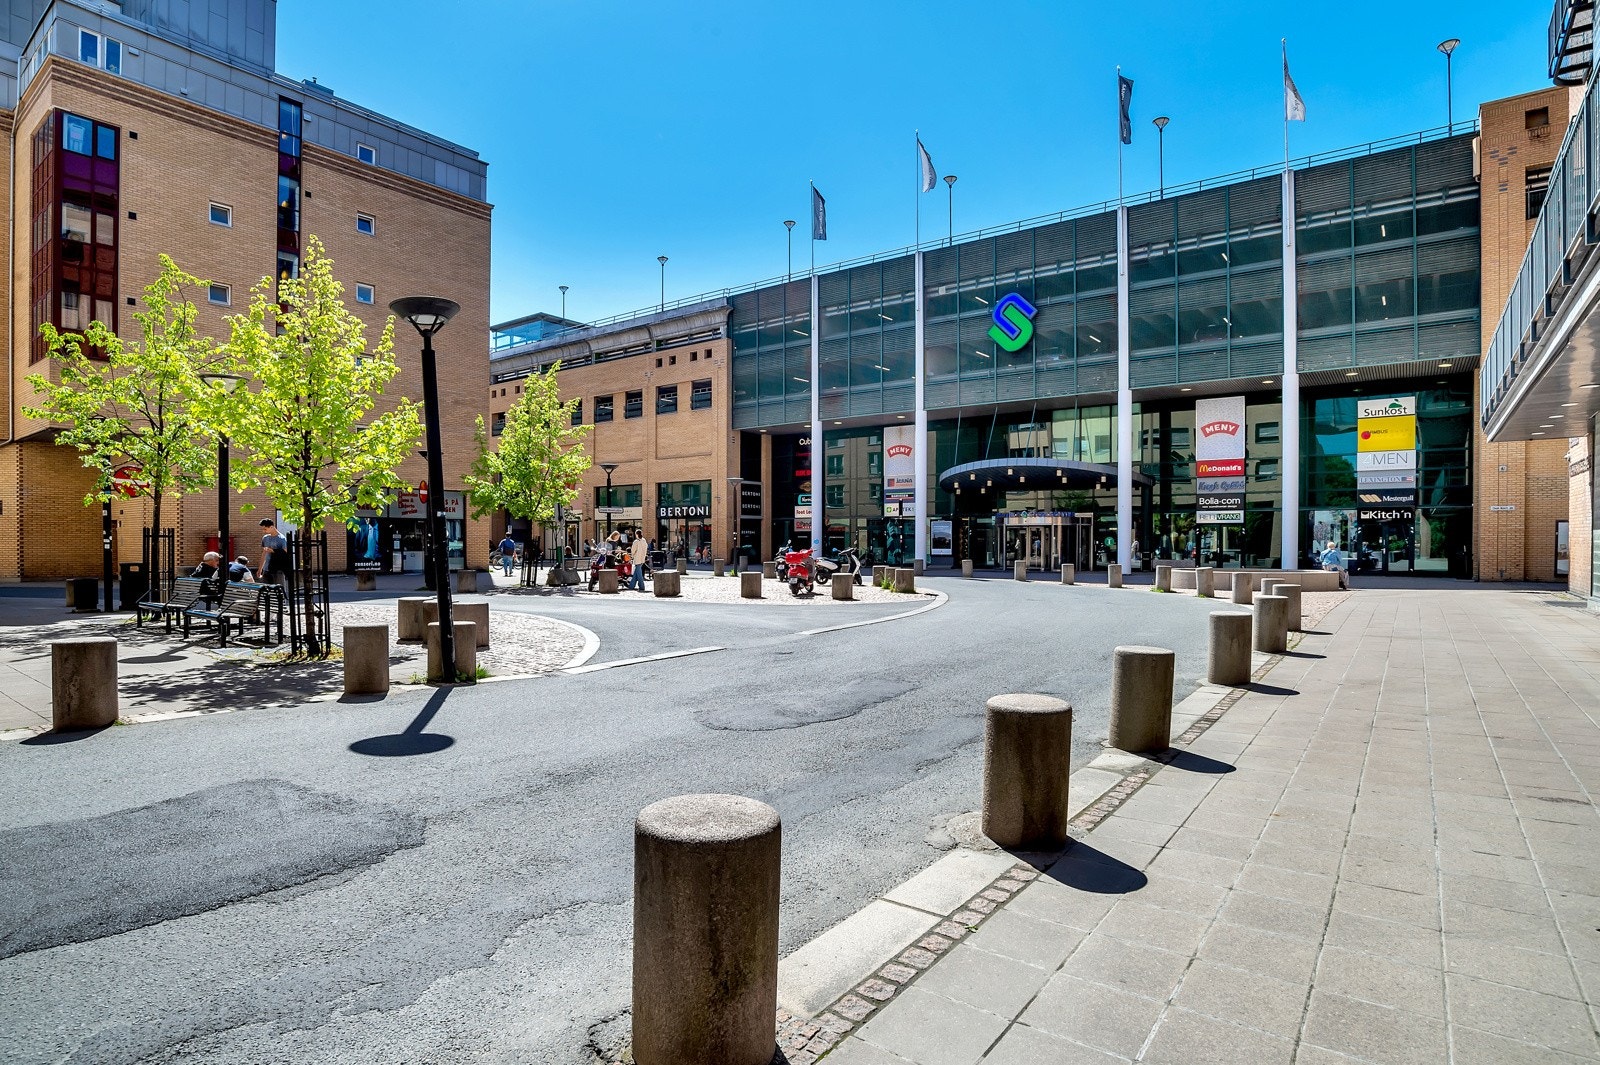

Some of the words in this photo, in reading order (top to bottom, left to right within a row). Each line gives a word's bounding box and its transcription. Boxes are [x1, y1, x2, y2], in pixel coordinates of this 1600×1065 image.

[1364, 406, 1407, 417] Sunkost
[1204, 423, 1236, 434] MENY
[799, 438, 812, 446] Cub
[889, 447, 910, 455] MENY
[1199, 464, 1242, 473] McDonald's
[660, 506, 709, 517] BERTONI
